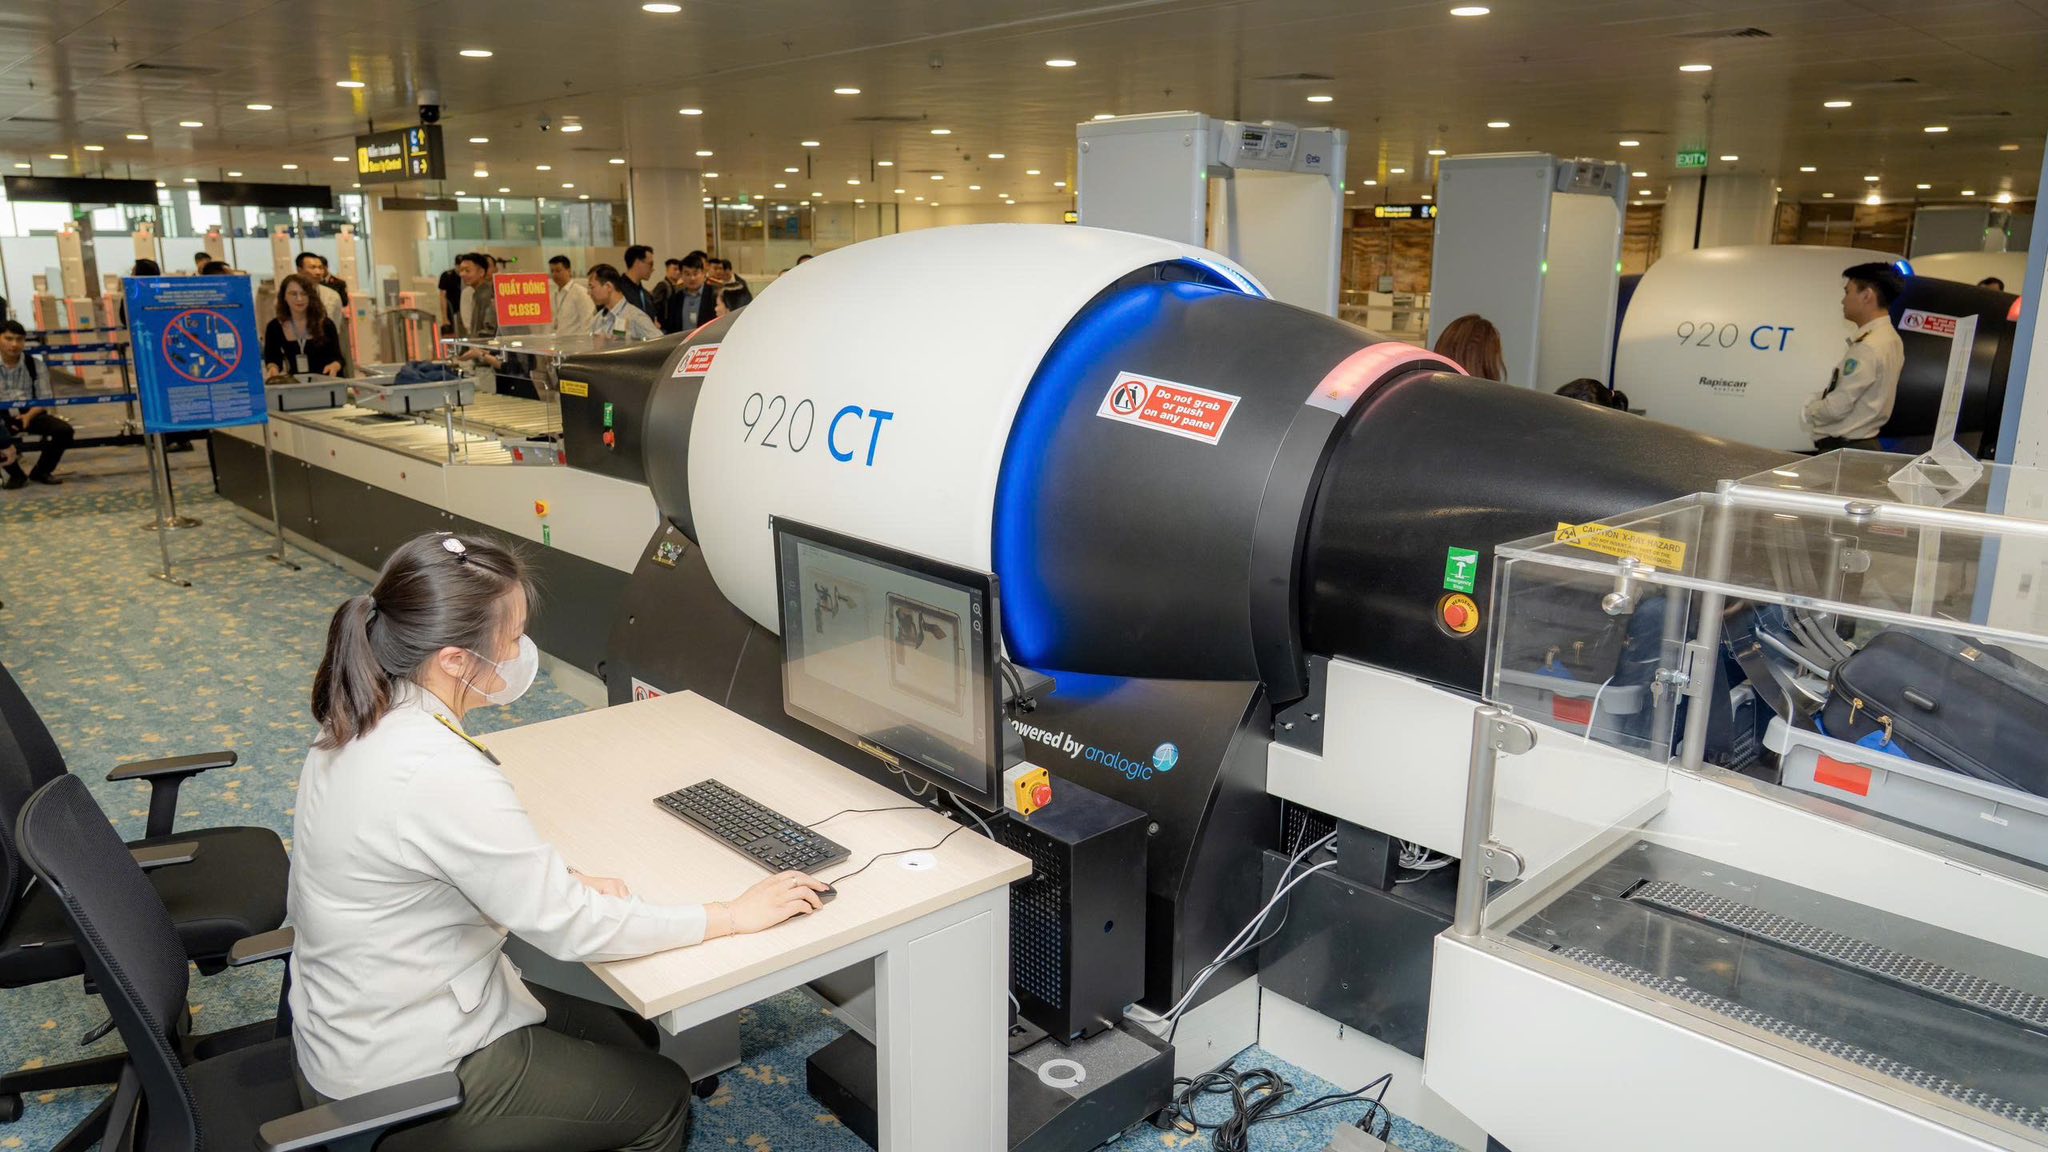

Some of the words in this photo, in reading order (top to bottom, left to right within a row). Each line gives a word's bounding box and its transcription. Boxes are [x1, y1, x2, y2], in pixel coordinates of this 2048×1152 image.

[1677, 154, 1700, 167] EXIT
[508, 303, 540, 316] CLOSED
[1677, 321, 1739, 348] 920
[1750, 325, 1795, 351] CT
[1699, 376, 1748, 388] Rapiscan
[1156, 389, 1171, 399] Do
[1173, 393, 1193, 404] not
[1193, 398, 1221, 411] grab
[1163, 402, 1176, 410] or
[1175, 404, 1204, 417] push
[743, 392, 815, 452] 920
[828, 405, 894, 466] CT
[1144, 408, 1158, 417] on
[1159, 411, 1181, 424] any
[1180, 417, 1216, 431] panel
[1582, 525, 1619, 540] CAUTION
[1647, 538, 1681, 553] HAZARD
[1010, 719, 1064, 749] owered
[1063, 734, 1085, 759] by
[1085, 746, 1153, 780] analogic
